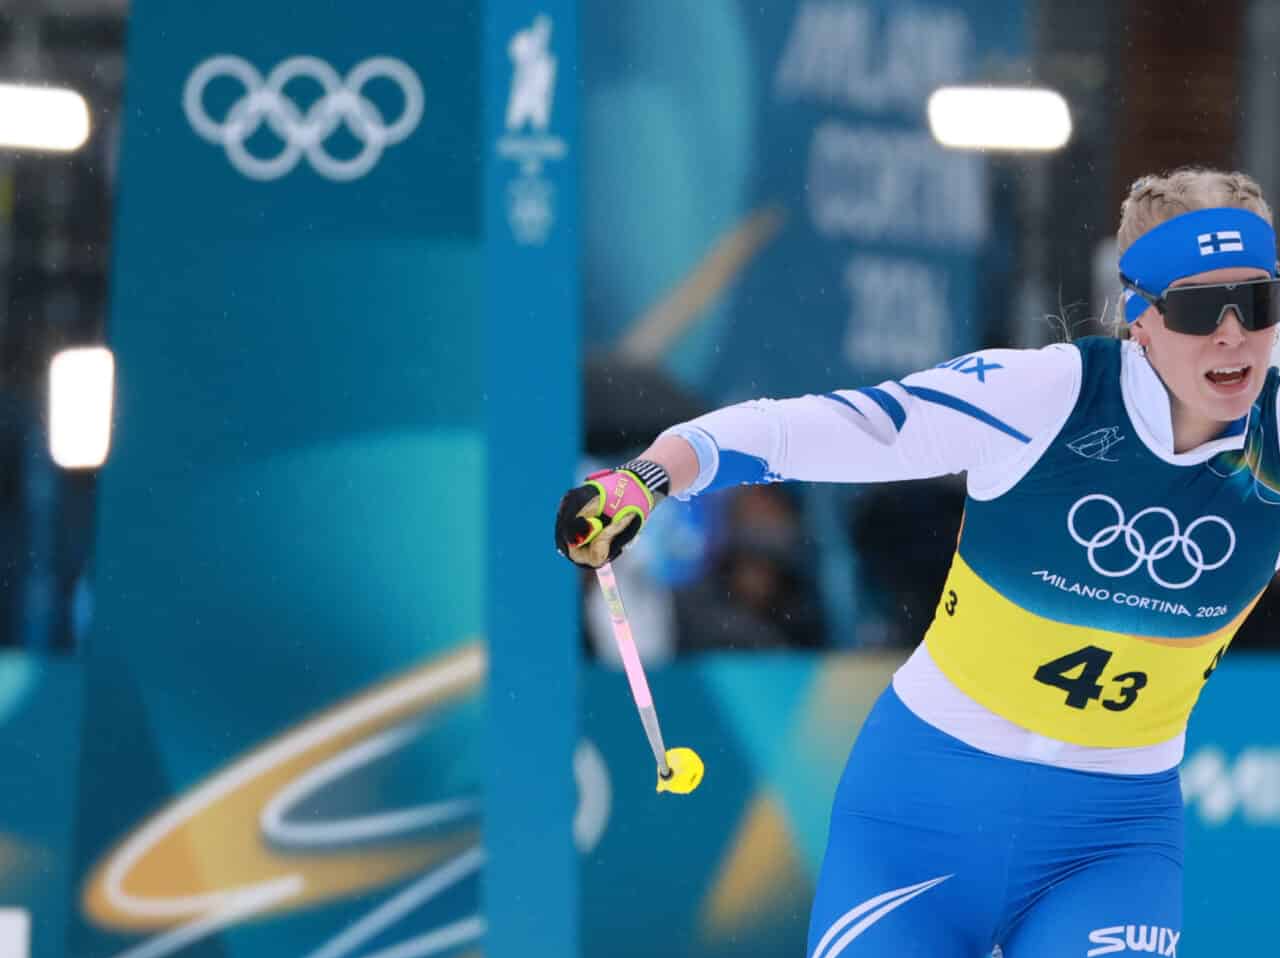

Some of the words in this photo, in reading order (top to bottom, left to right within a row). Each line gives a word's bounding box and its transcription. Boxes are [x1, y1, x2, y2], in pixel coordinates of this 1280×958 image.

[1032, 570, 1110, 600] MILANO
[1113, 592, 1192, 617] CORTINA
[1196, 605, 1228, 617] 2026
